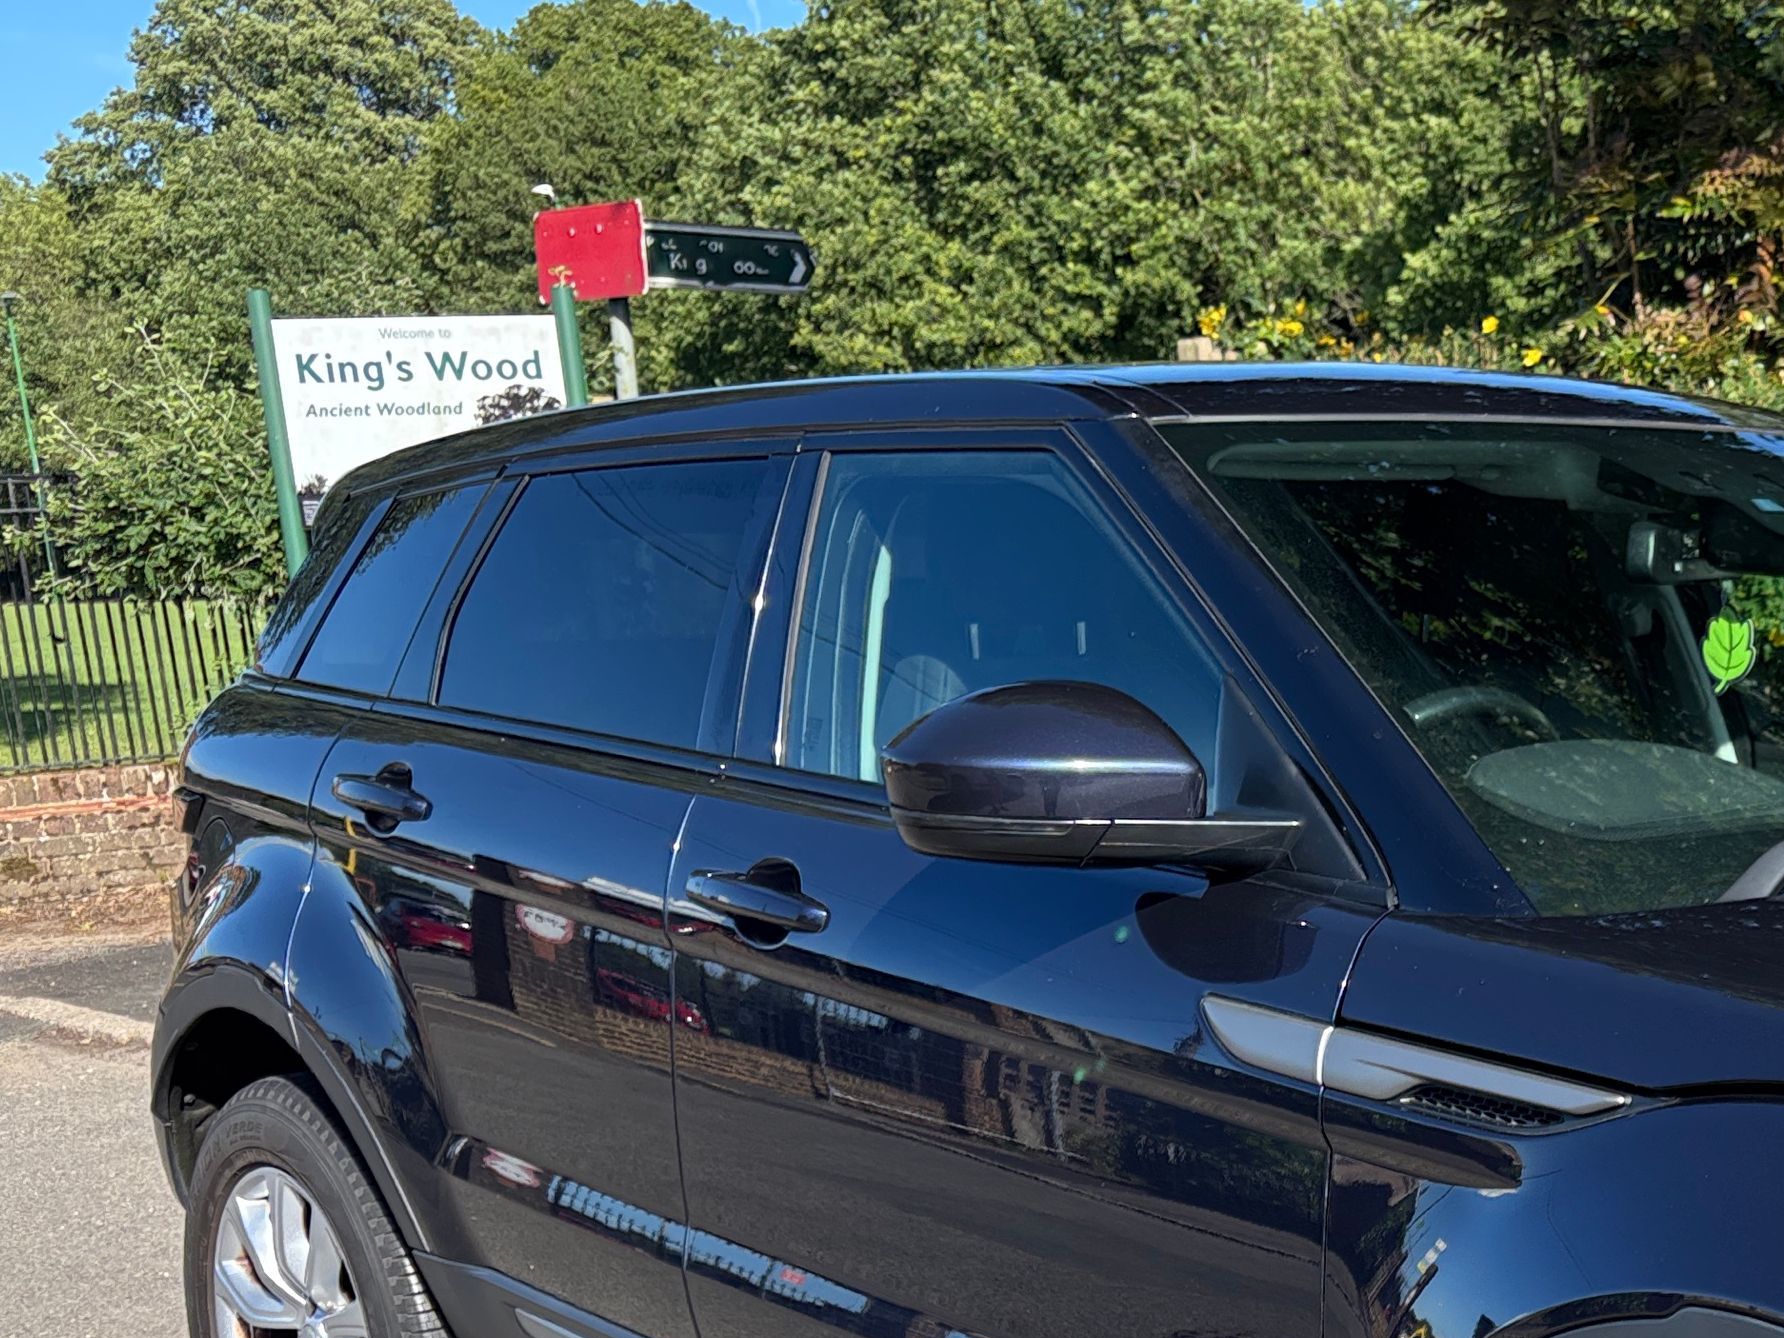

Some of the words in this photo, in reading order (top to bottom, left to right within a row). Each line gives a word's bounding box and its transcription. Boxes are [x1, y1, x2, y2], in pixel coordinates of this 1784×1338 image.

[378, 327, 435, 340] Welcome
[438, 327, 452, 339] to
[295, 350, 414, 392] King's
[424, 349, 544, 382] Wood
[305, 404, 371, 419] Ancient
[377, 401, 463, 417] Woodland
